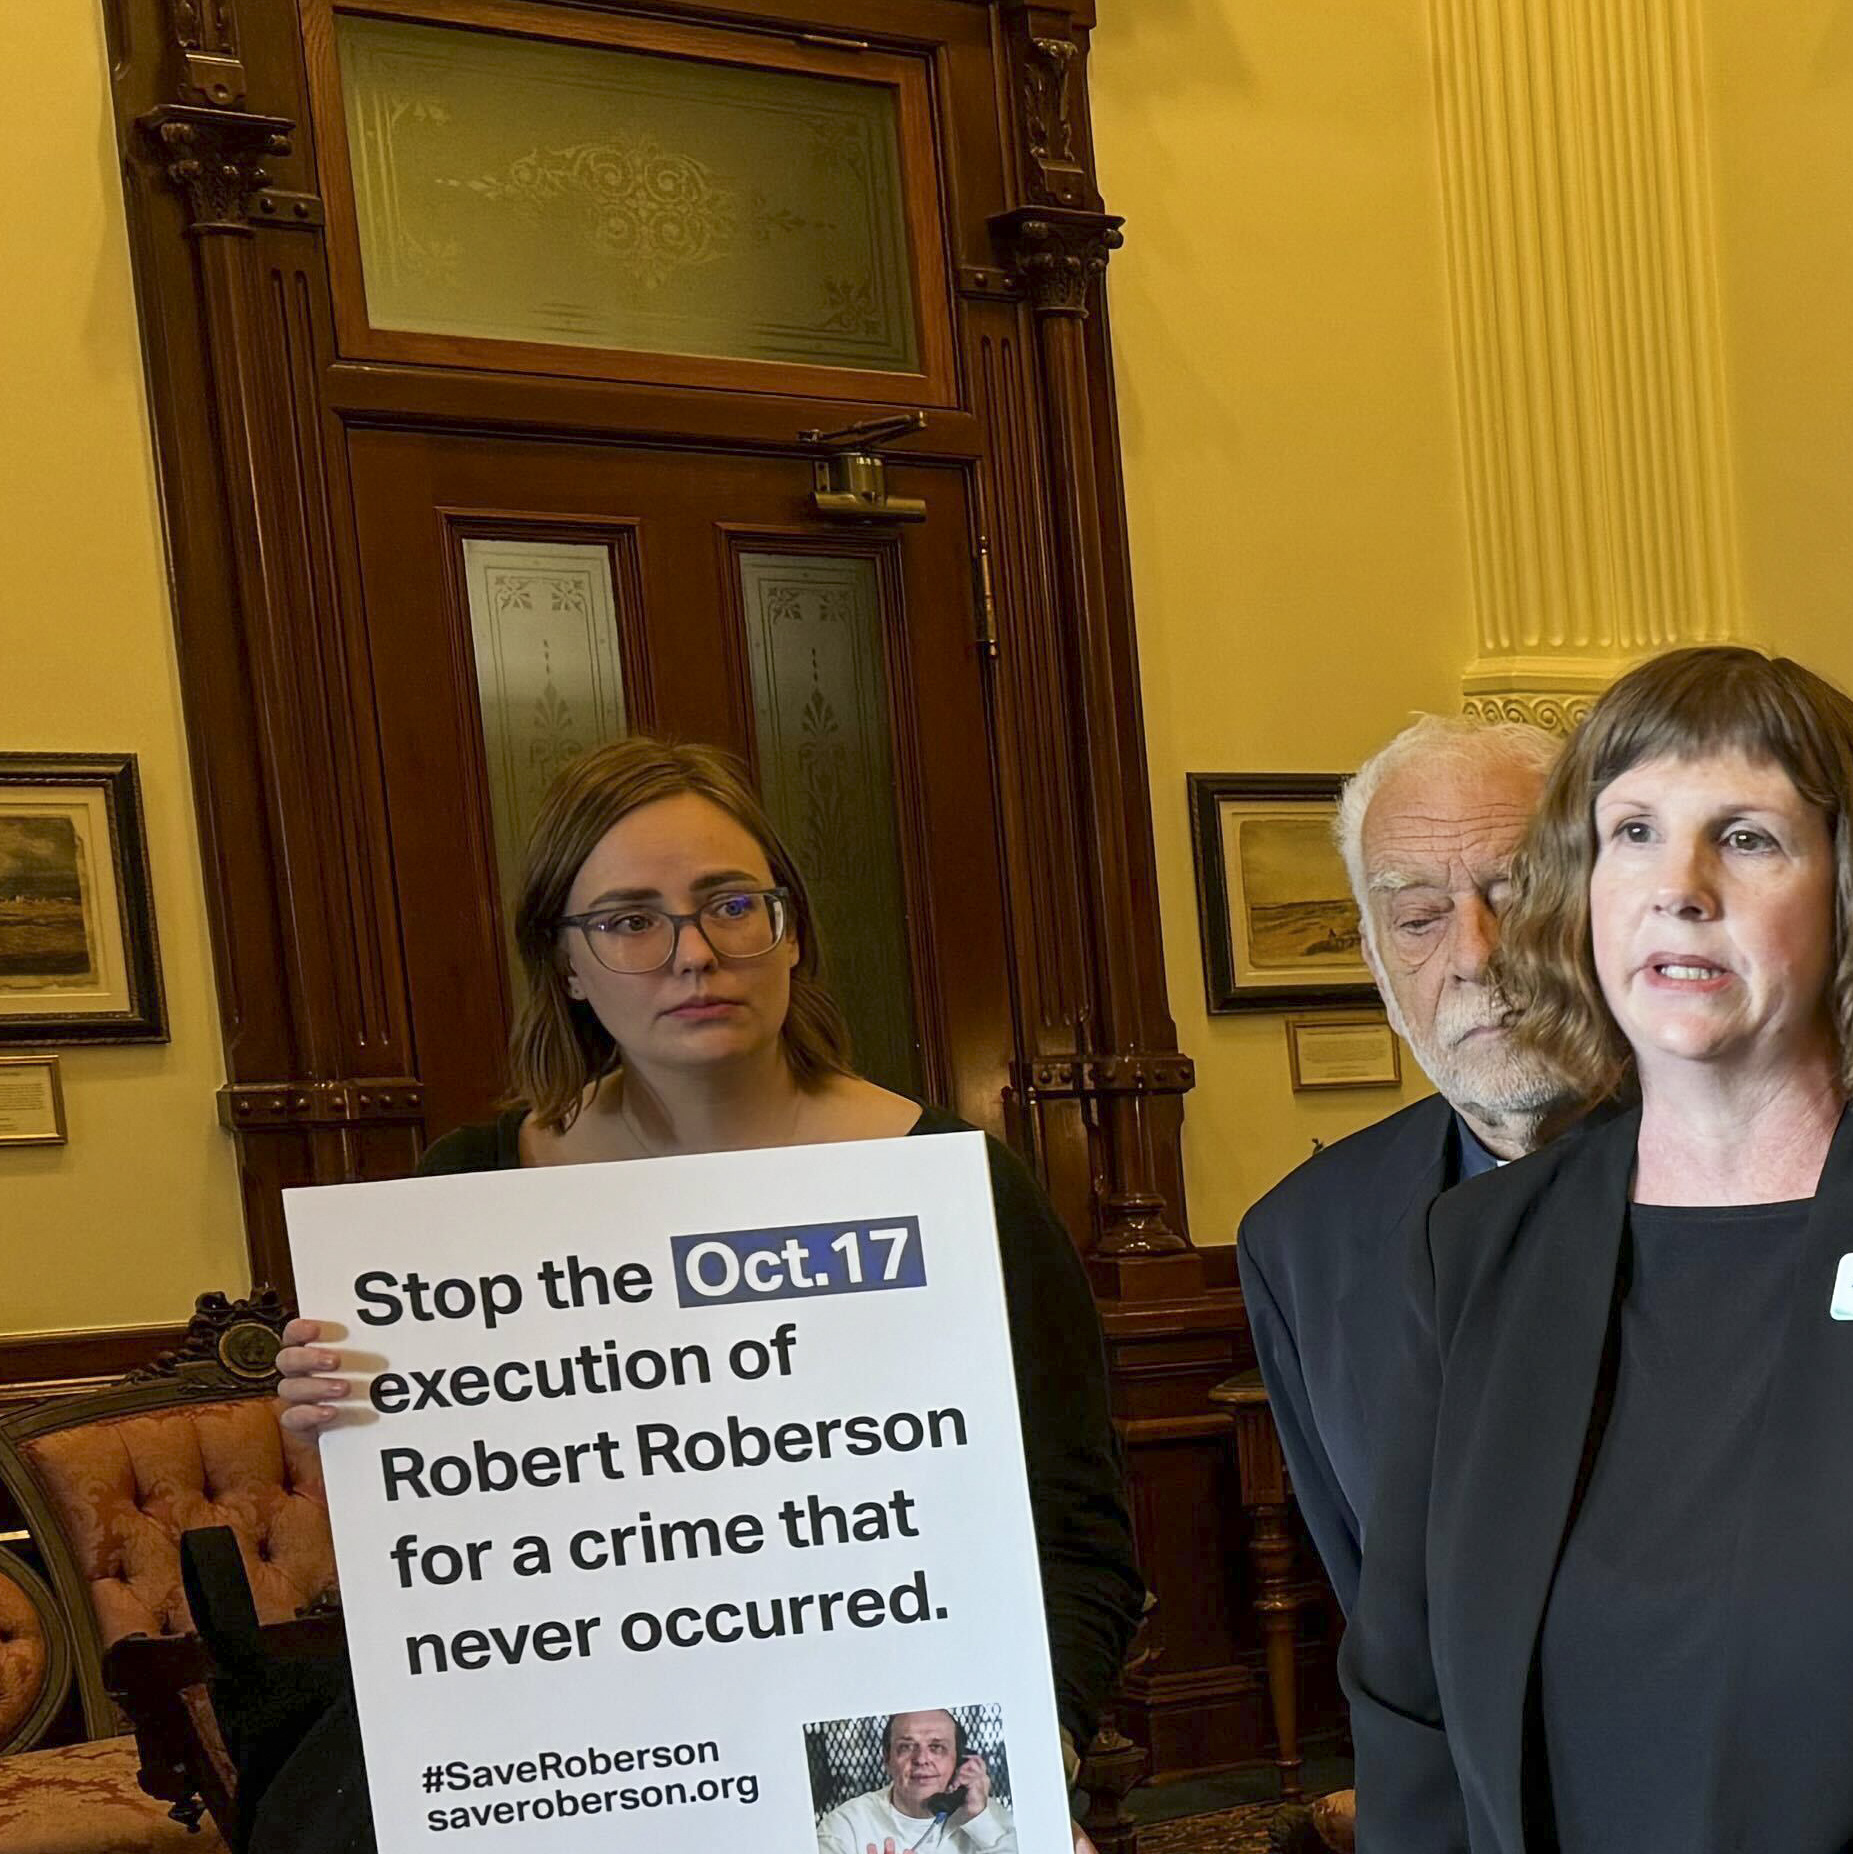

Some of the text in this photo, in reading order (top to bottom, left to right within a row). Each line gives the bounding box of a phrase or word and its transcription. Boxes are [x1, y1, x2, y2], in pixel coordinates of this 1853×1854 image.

[354, 1227, 909, 1329] Stop the Oct.17
[369, 1323, 797, 1414] execution of
[380, 1407, 968, 1501] Robert Roberson
[390, 1489, 920, 1588] for a crime that
[405, 1570, 948, 1675] never occurred.
[422, 1740, 720, 1794] #SaveRoberson
[427, 1774, 760, 1832] saveroberson.org
